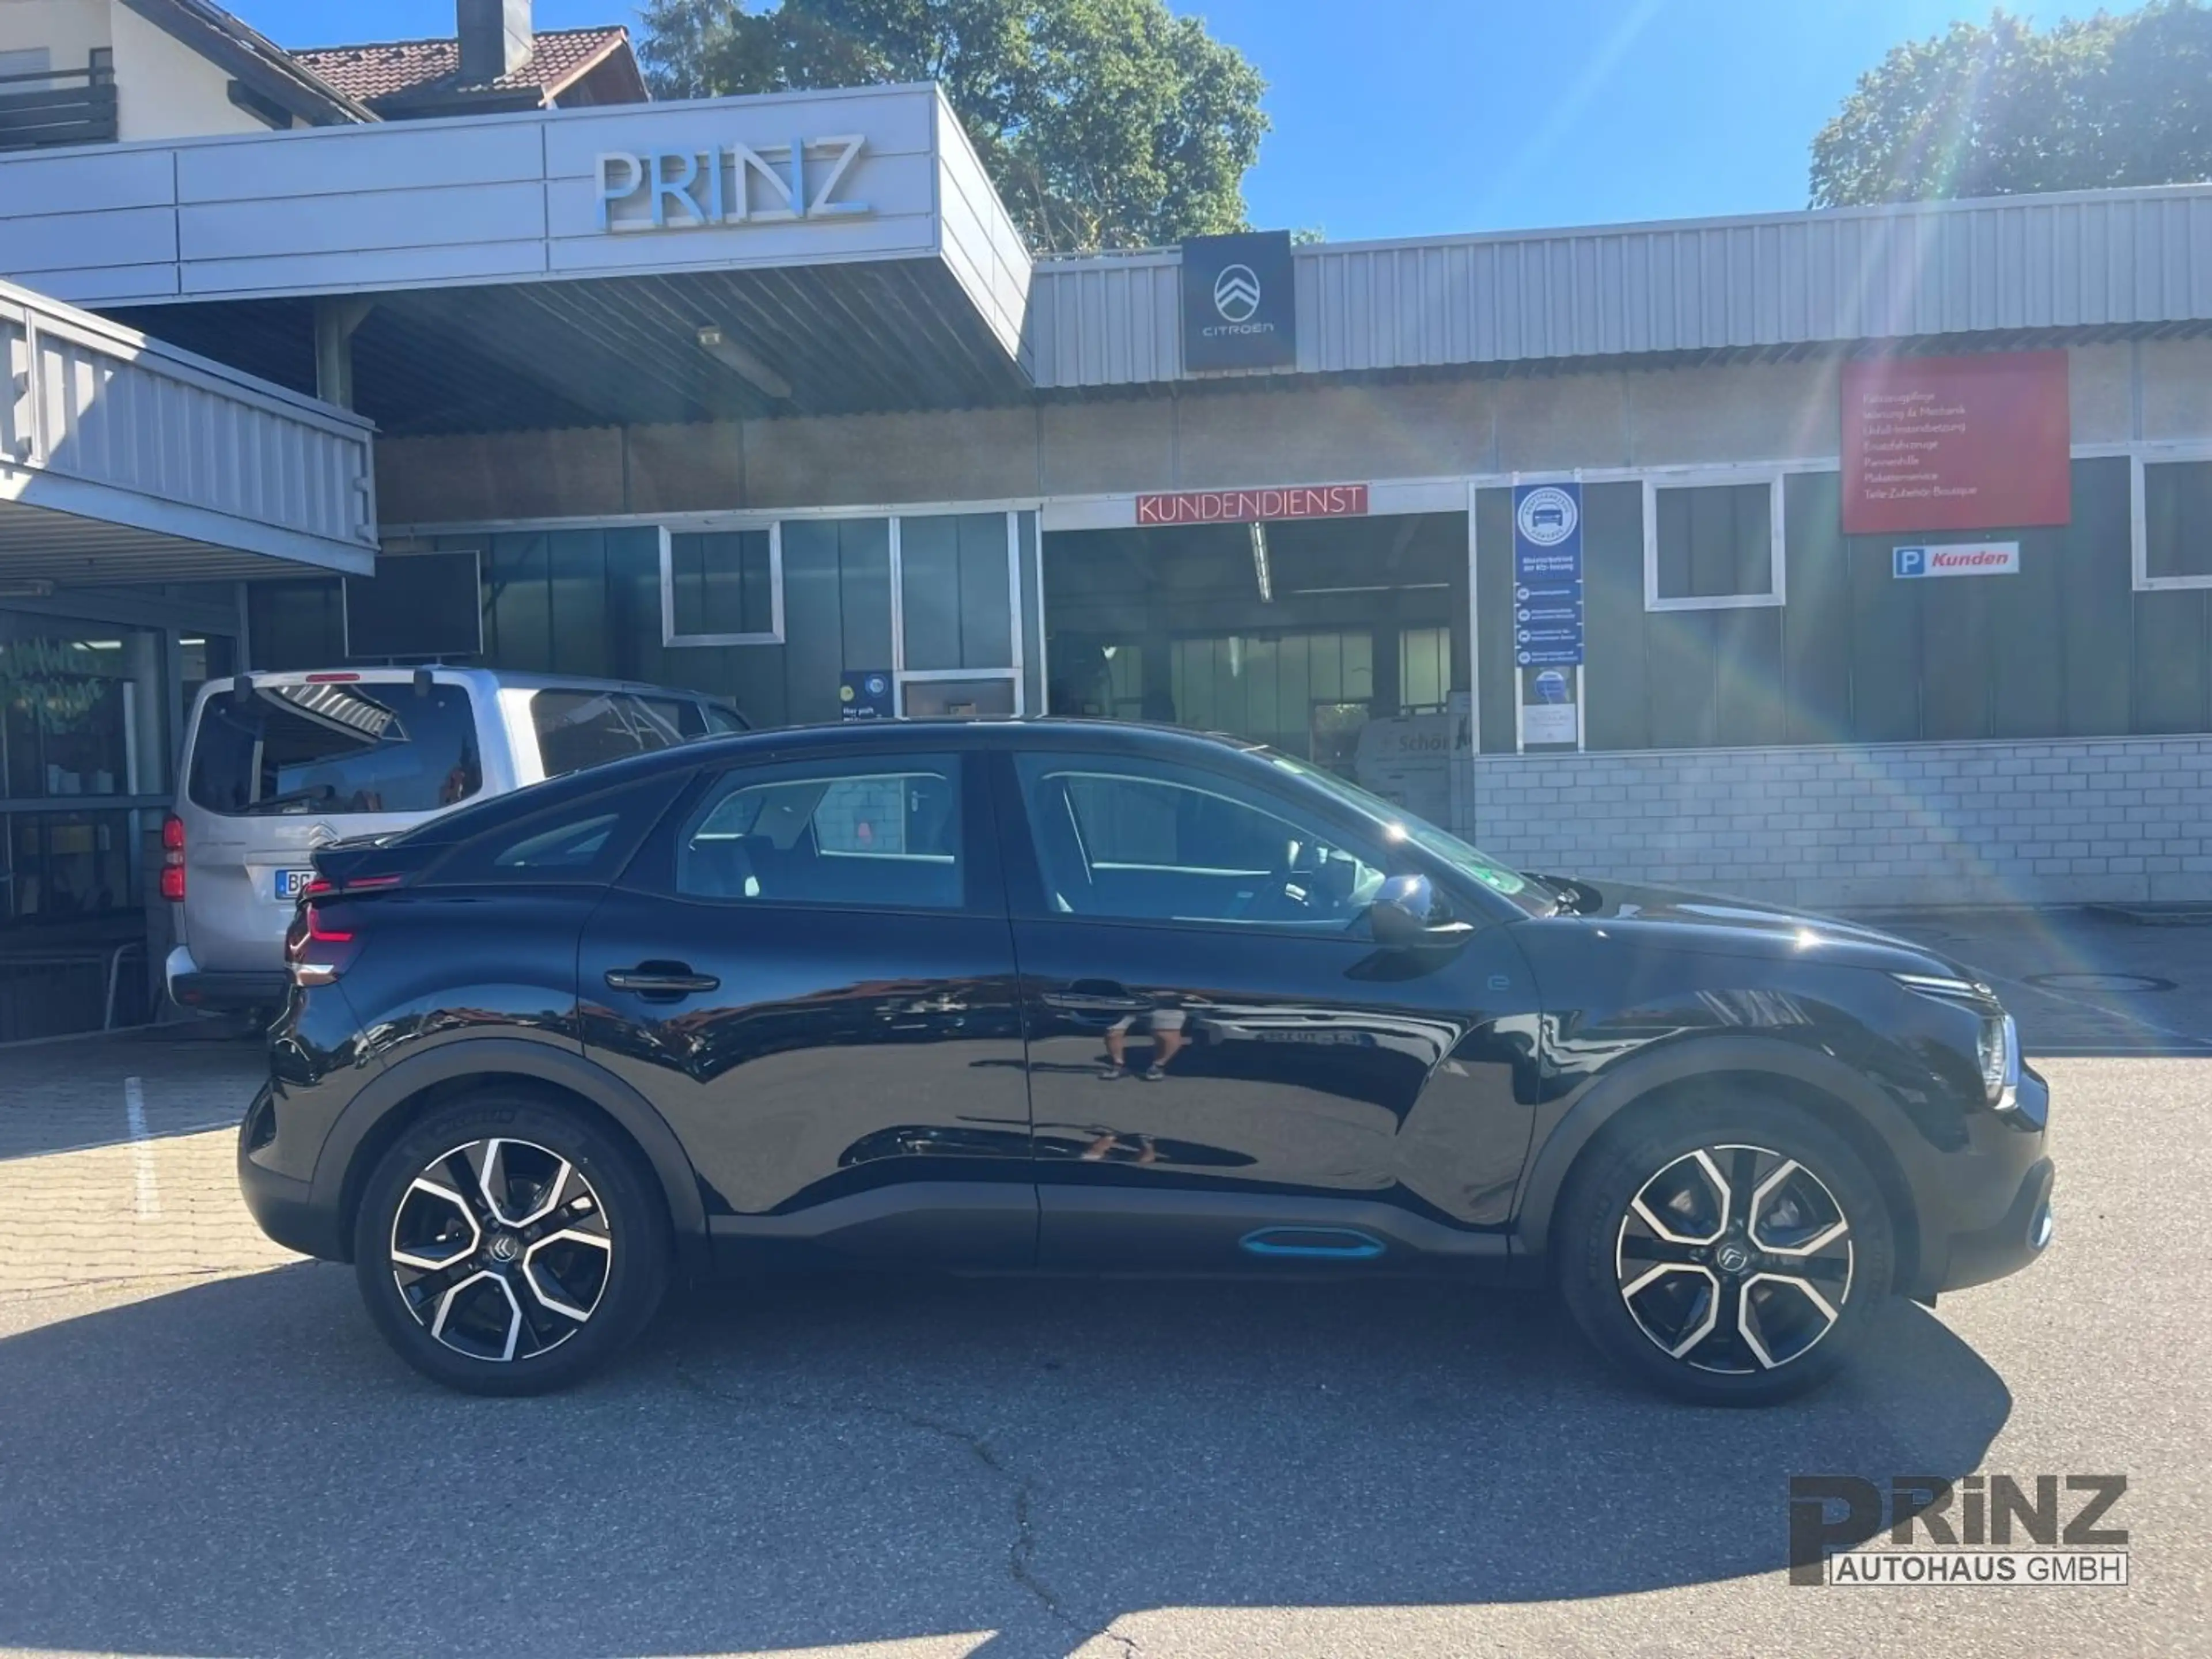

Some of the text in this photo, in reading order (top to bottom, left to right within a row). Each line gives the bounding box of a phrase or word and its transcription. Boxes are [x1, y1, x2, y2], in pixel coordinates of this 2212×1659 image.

[594, 134, 870, 232] PRINZ
[1139, 487, 1363, 522] KUNDENDIENST
[1902, 551, 2009, 573] P Kunden
